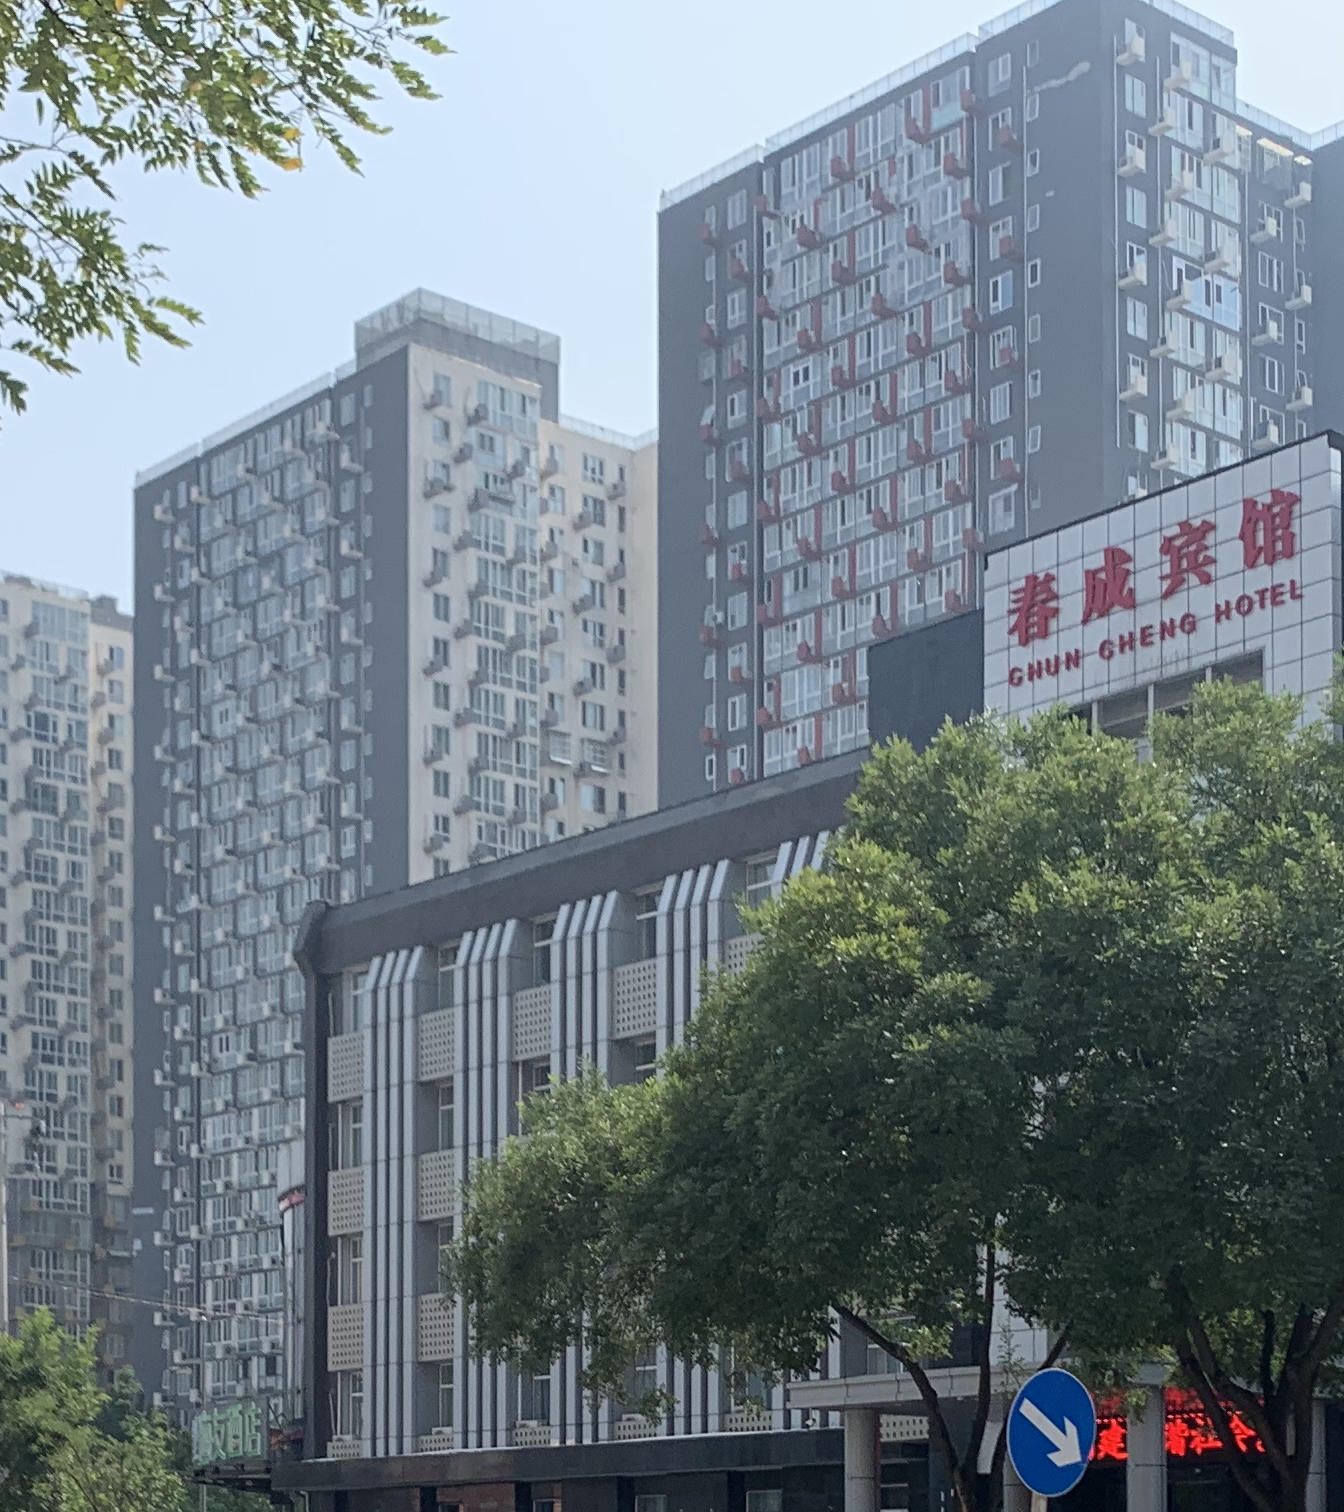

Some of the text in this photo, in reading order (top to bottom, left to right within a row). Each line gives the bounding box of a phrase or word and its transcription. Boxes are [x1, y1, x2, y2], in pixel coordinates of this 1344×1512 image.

[1008, 489, 1301, 647] 春成宾馆
[1008, 579, 1304, 688] CHUN CHENG HOTEL
